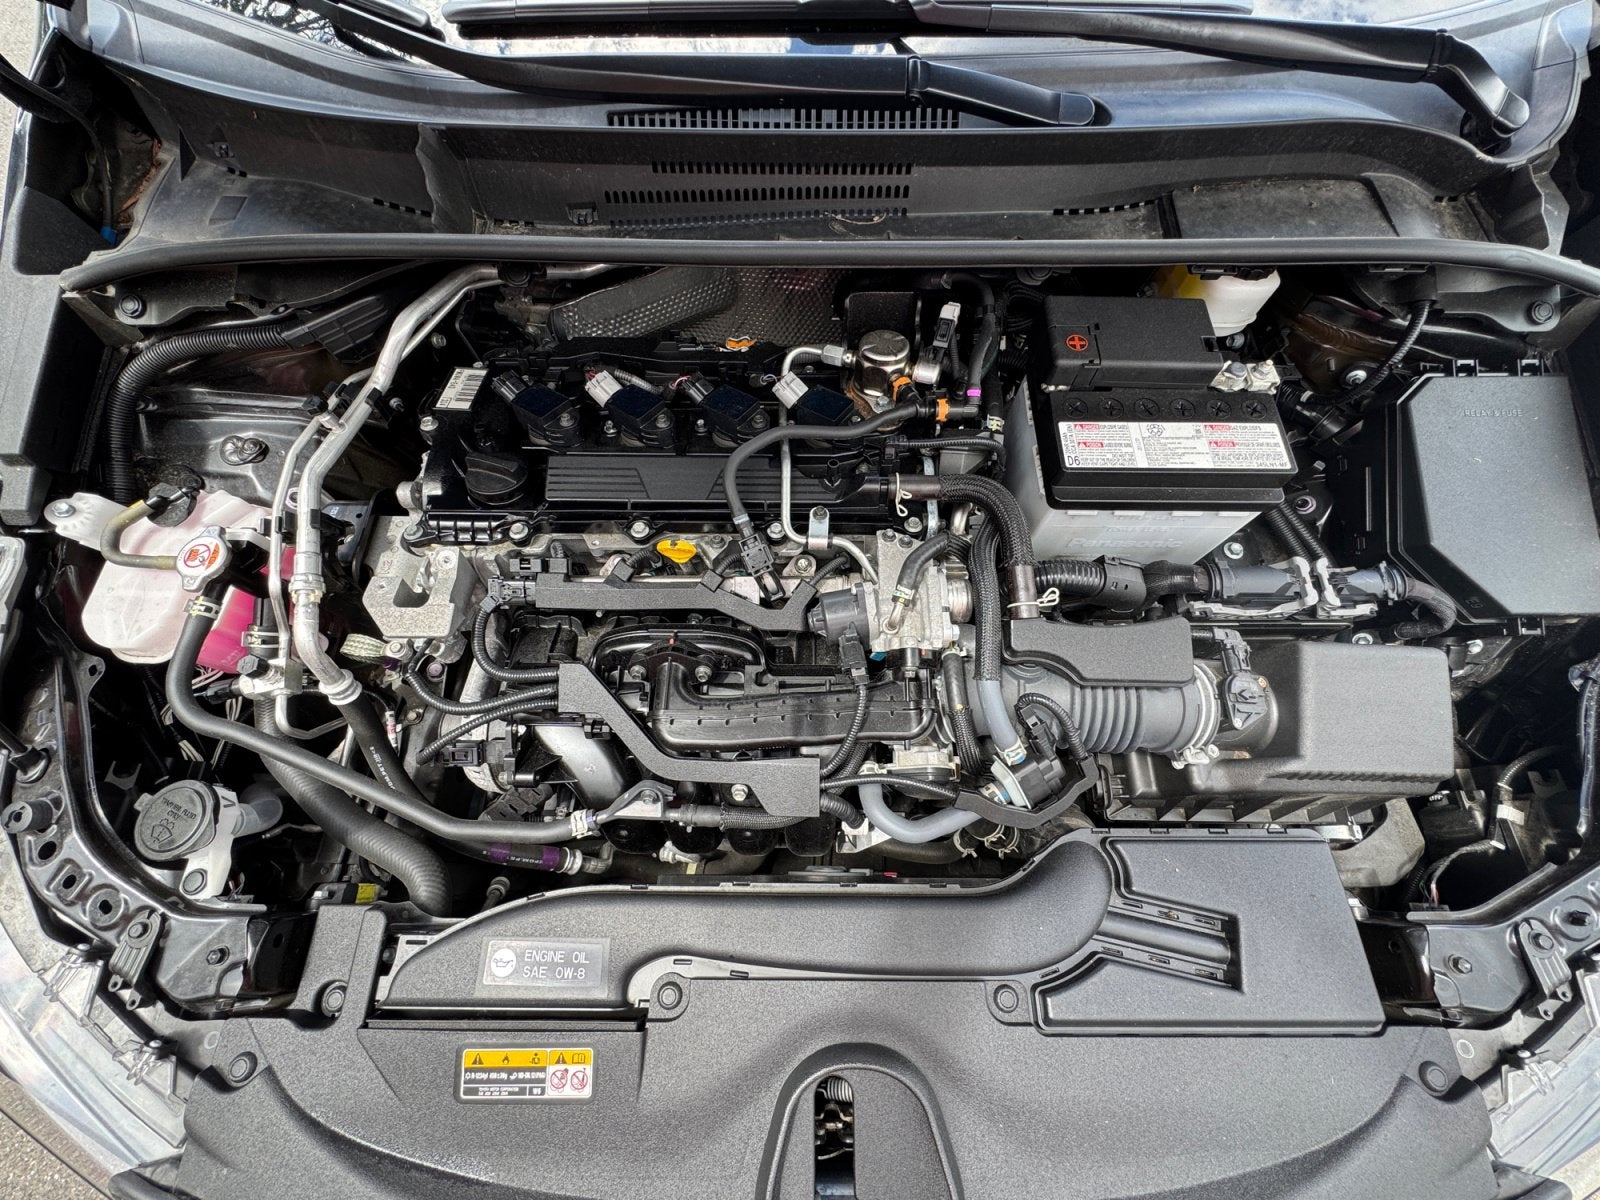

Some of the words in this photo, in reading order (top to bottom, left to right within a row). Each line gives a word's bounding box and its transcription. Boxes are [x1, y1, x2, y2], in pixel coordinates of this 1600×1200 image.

[1463, 408, 1491, 417] RELAY
[1501, 409, 1523, 417] FUSE
[1067, 455, 1081, 466] D6
[524, 949, 565, 963] ENGINE
[572, 951, 590, 964] OIL
[522, 965, 549, 978] SAE
[555, 967, 586, 980] 0W-8
